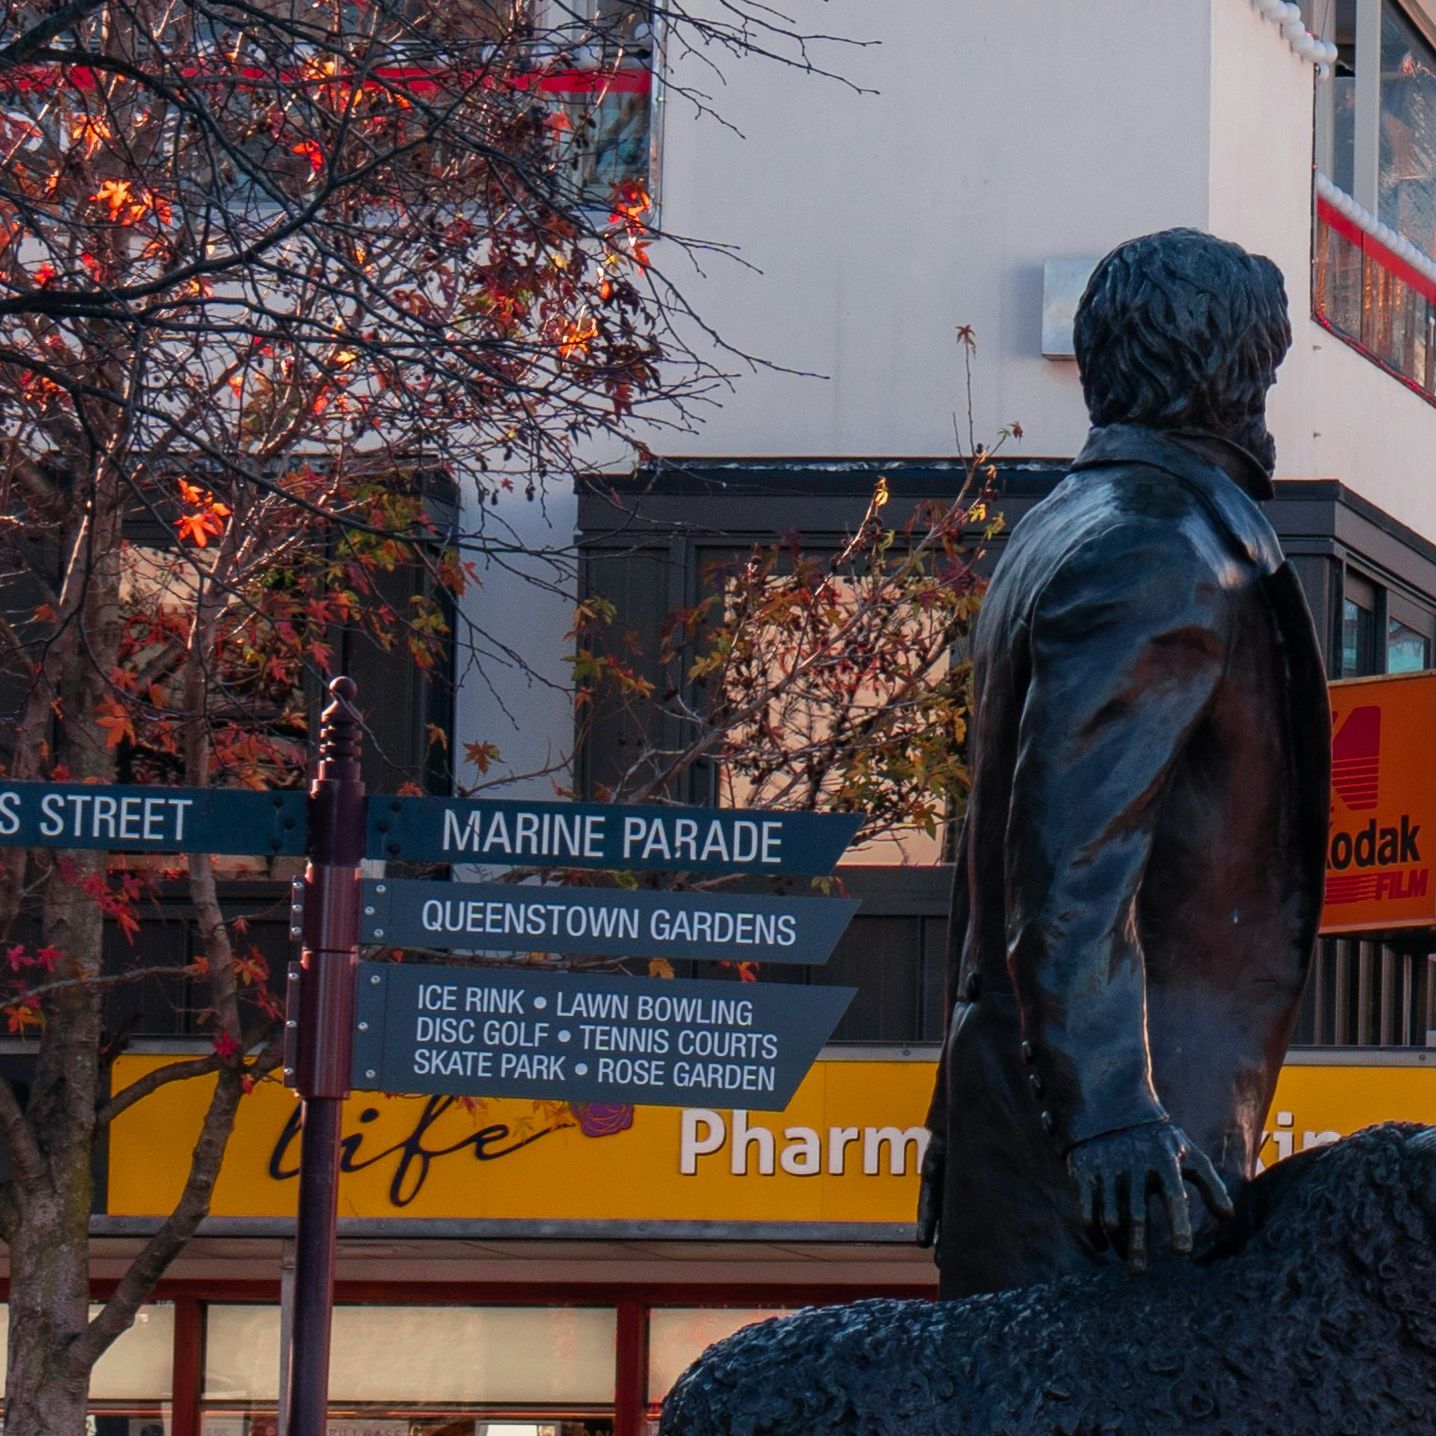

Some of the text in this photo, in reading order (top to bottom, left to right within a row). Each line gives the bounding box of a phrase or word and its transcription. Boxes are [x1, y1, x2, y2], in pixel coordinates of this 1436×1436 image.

[40, 796, 193, 842] STREET
[443, 809, 783, 864] MARINE PARADE
[1375, 868, 1429, 901] FILM
[422, 899, 797, 946] QUEENSTOWN GARDENS
[418, 984, 753, 1027] ICE RINK LAWN BOWLING
[416, 1017, 778, 1060] DISC GOLF TENNIS COURTS
[413, 1049, 776, 1092] SKATE PARK ROSE GARDEN
[679, 1108, 934, 1177] Pharm
